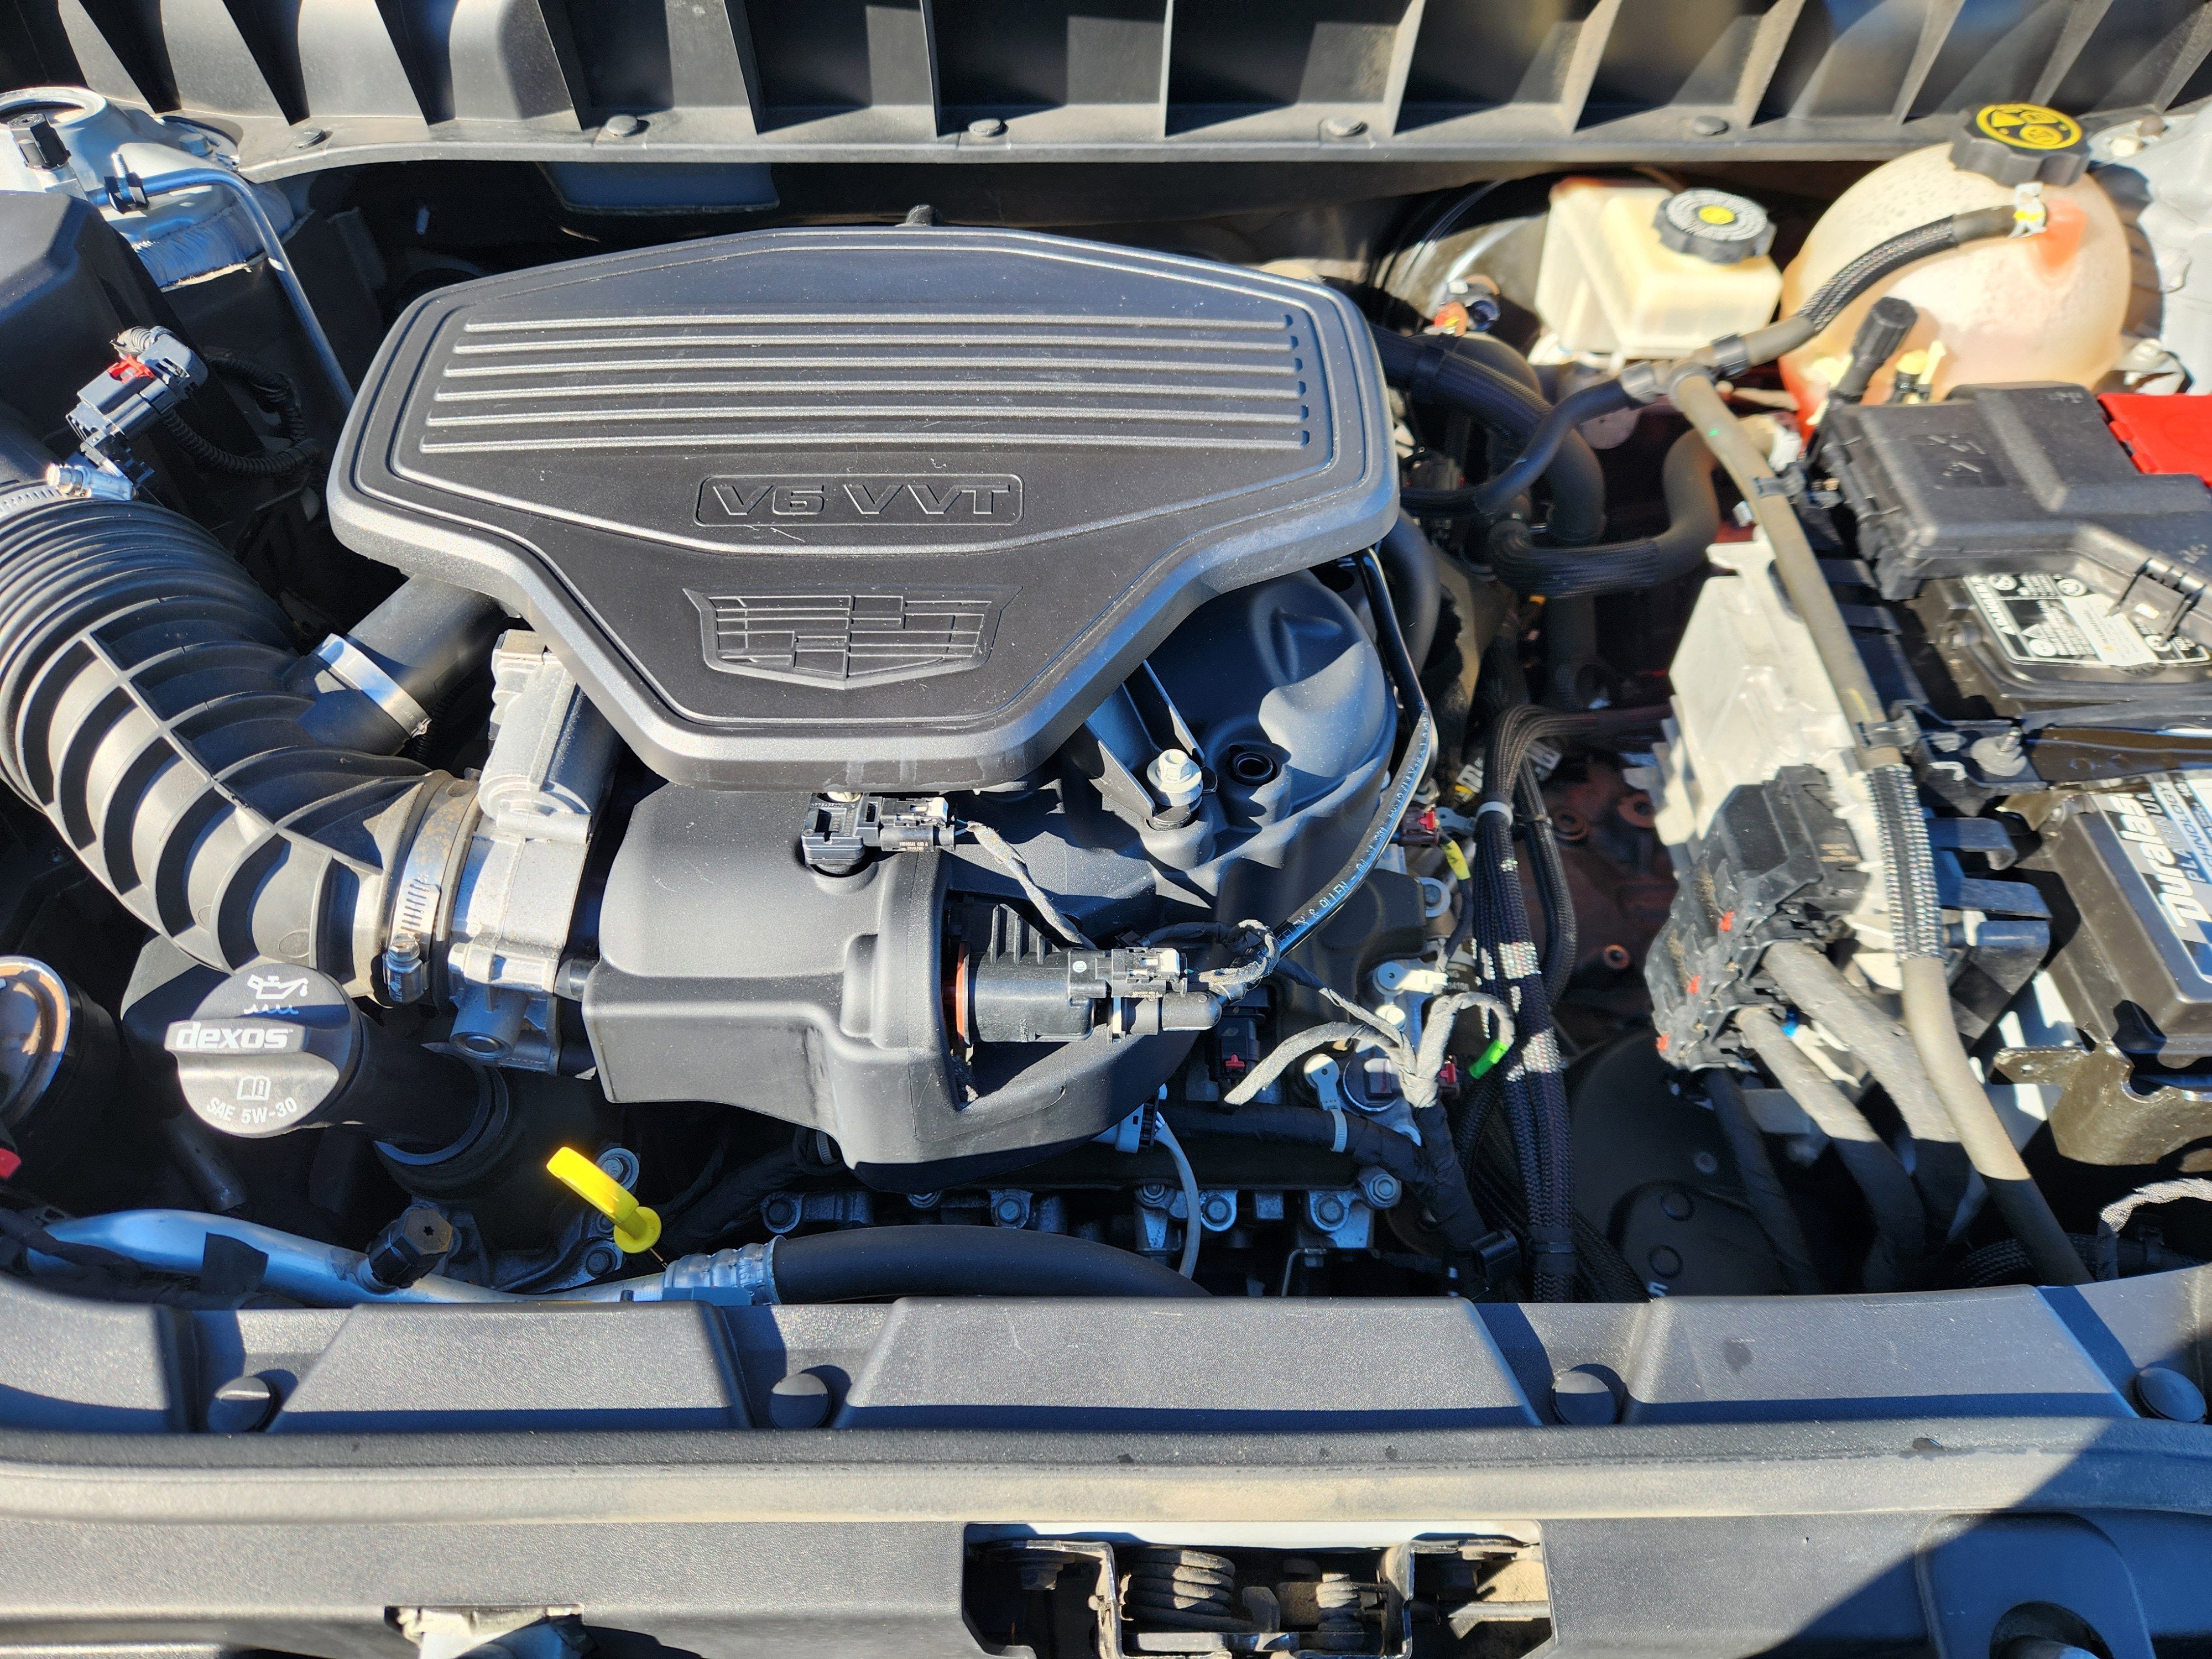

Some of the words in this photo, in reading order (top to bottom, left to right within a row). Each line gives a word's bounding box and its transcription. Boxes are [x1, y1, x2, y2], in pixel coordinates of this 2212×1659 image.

[712, 483, 825, 516] V6
[843, 483, 1011, 515] VVT
[2107, 792, 2212, 928] Duralas
[176, 1021, 288, 1050] dexos
[206, 1097, 236, 1122] SAE
[241, 1097, 298, 1124] 5W-30
